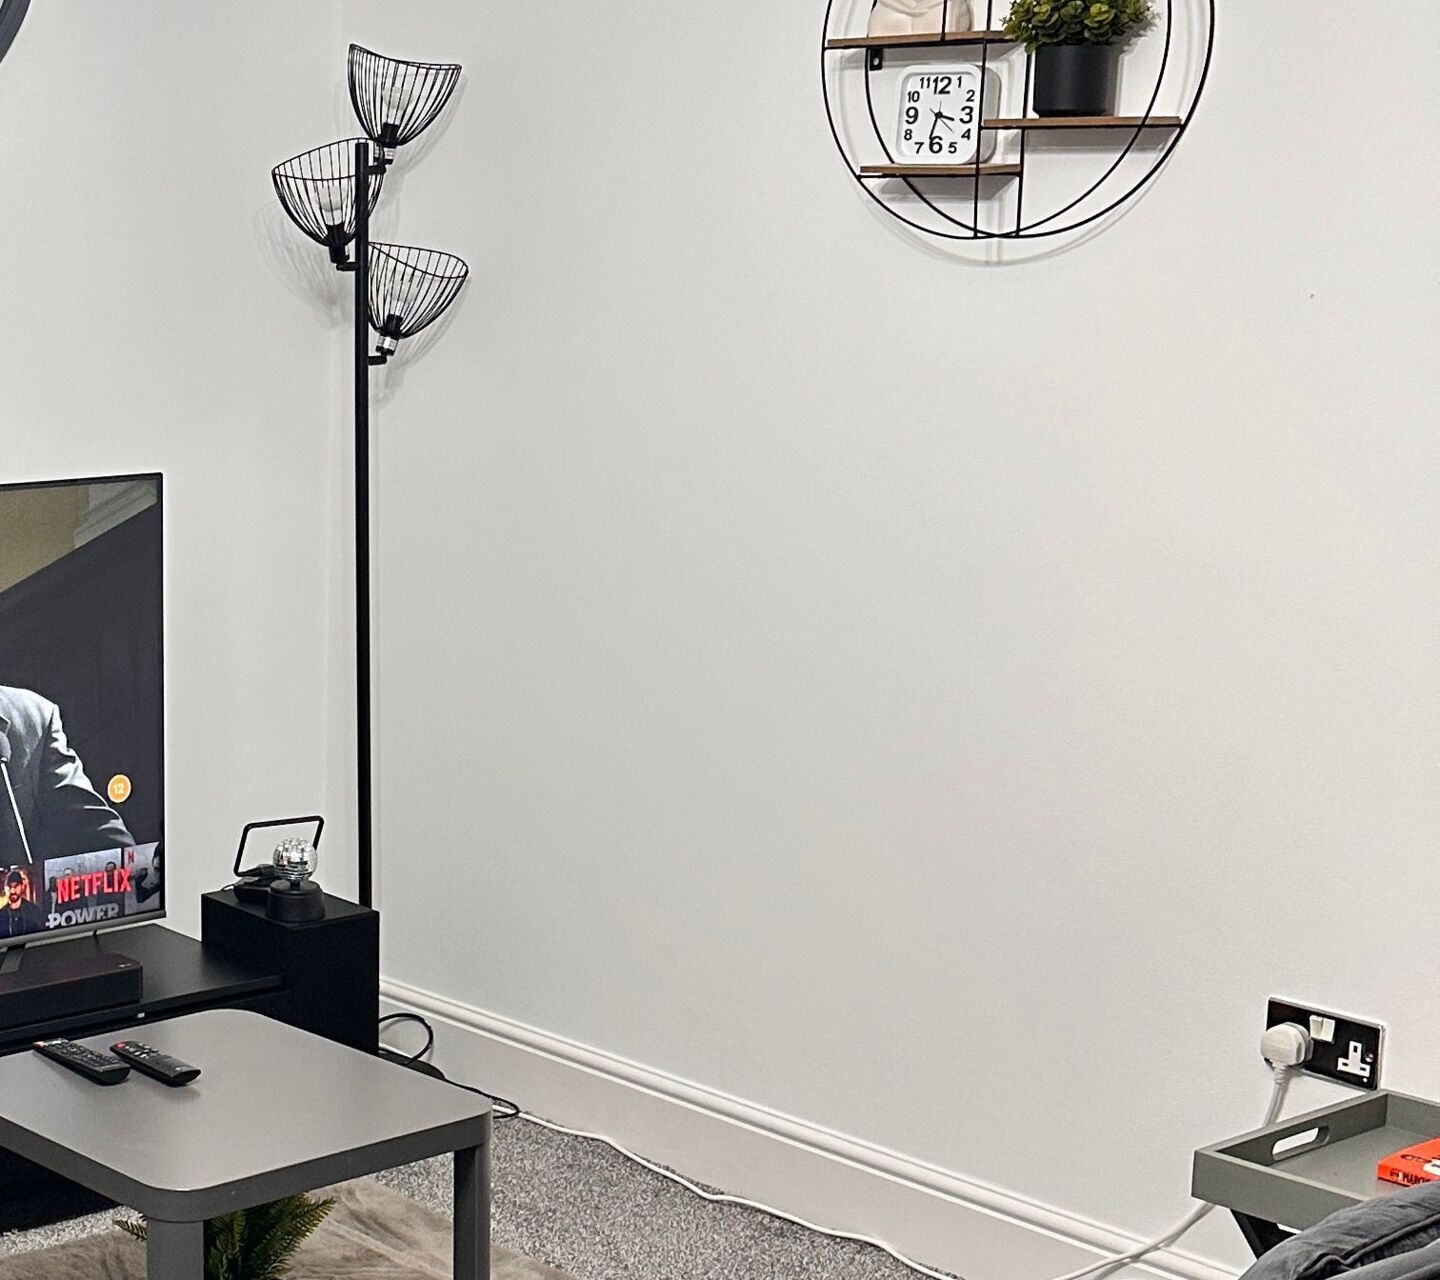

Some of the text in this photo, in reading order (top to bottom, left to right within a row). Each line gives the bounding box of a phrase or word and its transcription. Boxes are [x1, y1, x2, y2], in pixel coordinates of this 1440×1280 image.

[920, 76, 931, 89] 11
[932, 76, 952, 95] 12
[957, 76, 962, 88] 1
[907, 90, 920, 103] 10
[965, 89, 975, 102] 2
[905, 106, 919, 125] 9
[959, 105, 974, 124] 3
[903, 128, 913, 141] 8
[961, 128, 971, 140] 4
[914, 141, 924, 154] 7
[928, 135, 943, 154] 6
[948, 141, 958, 154] 5
[113, 780, 126, 795] 12
[57, 868, 133, 904] NETFLIX
